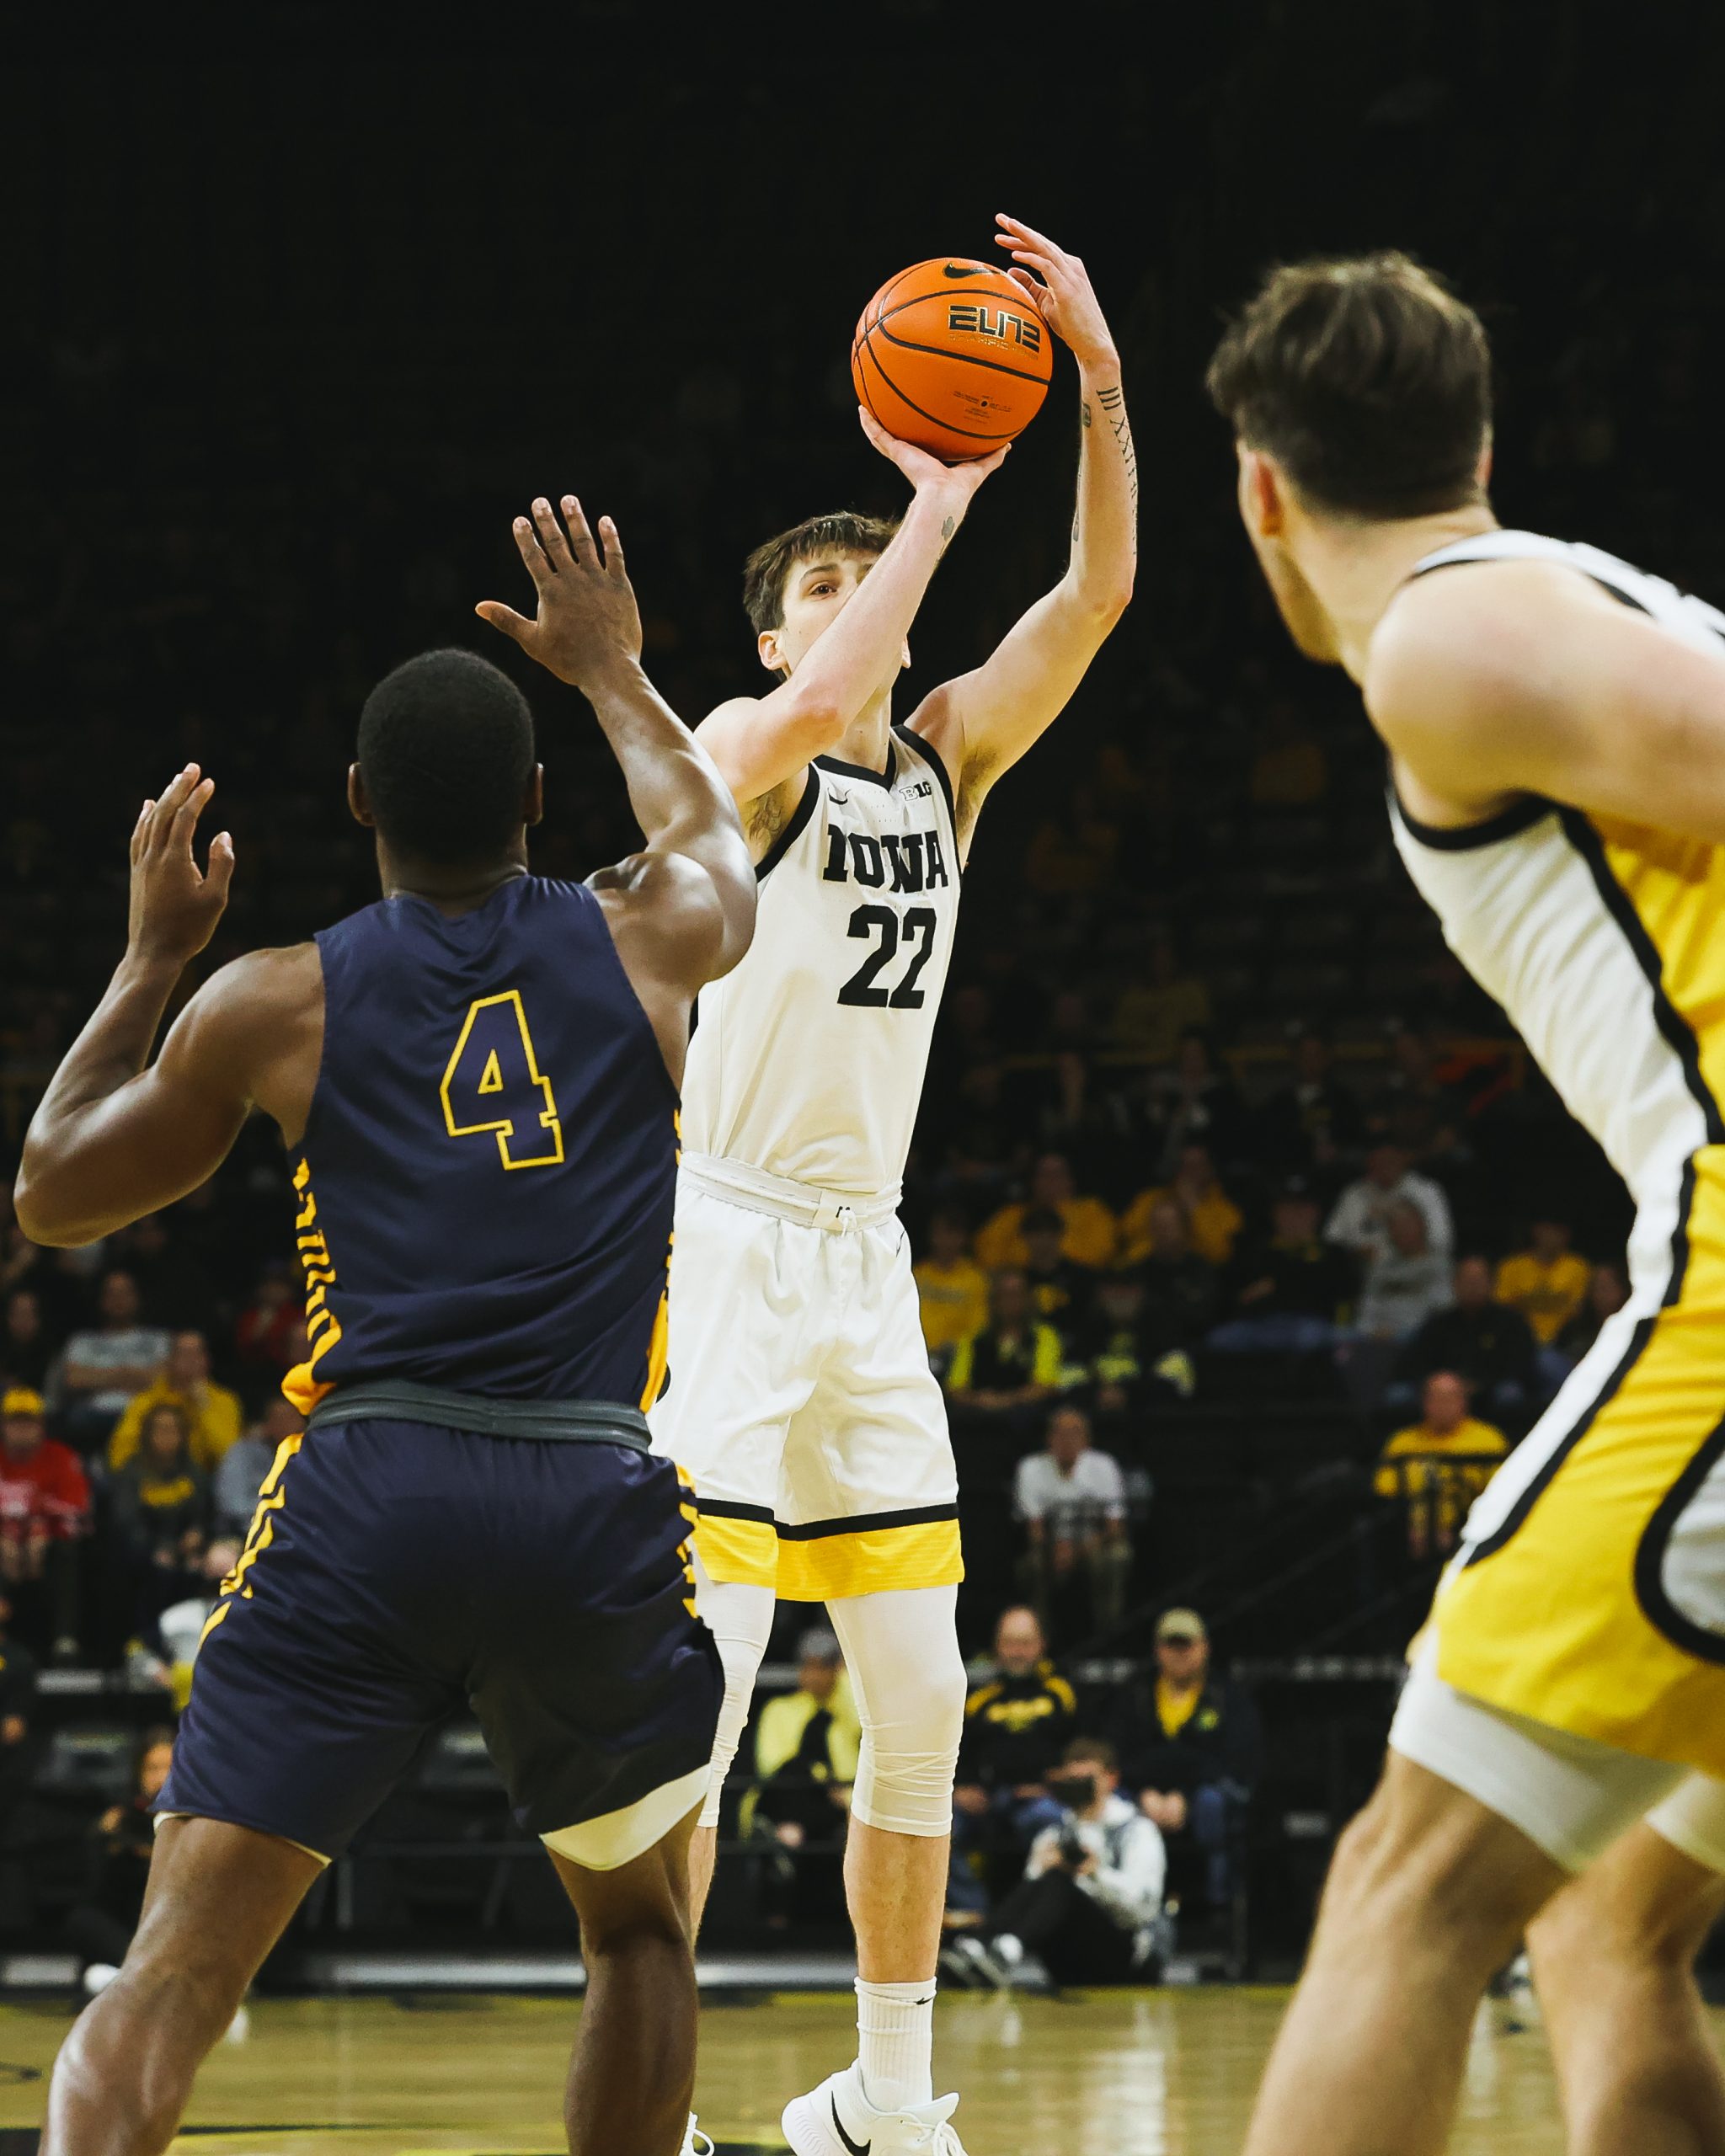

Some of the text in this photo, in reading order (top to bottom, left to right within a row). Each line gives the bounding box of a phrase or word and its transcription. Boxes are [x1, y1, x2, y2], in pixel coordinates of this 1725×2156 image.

[948, 304, 1041, 354] ELITE
[823, 824, 949, 894] IOWA
[837, 904, 937, 1009] 22
[440, 990, 564, 1171] 4
